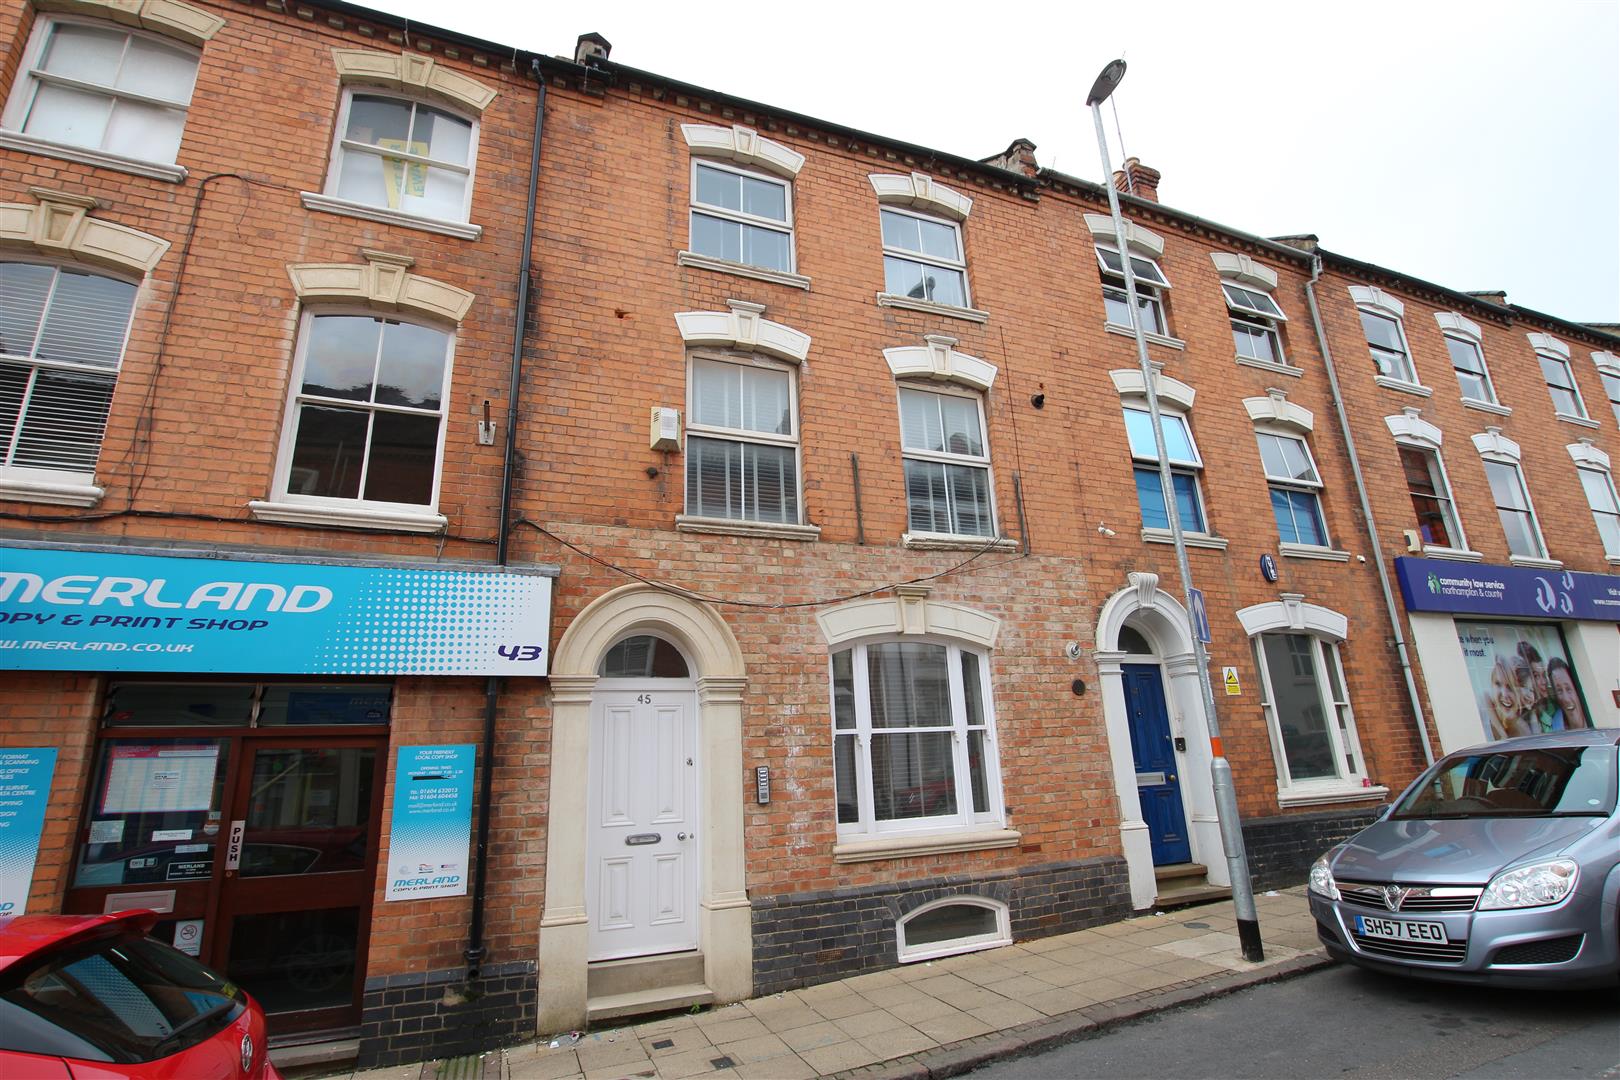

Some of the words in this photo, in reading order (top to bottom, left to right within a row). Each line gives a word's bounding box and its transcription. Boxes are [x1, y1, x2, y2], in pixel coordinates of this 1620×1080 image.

[0, 571, 333, 613] MERLAND
[1440, 578, 1472, 589] community
[1472, 579, 1484, 588] law
[1484, 580, 1505, 590] service
[1442, 586, 1478, 598] northampton
[61, 614, 83, 626] &
[89, 615, 183, 629] PRINT
[187, 618, 269, 631] SHOP
[498, 645, 542, 661] 43
[637, 694, 651, 705] 45
[229, 827, 242, 862] PUSH
[393, 875, 460, 887] MERLAND
[1364, 918, 1402, 937] SH57
